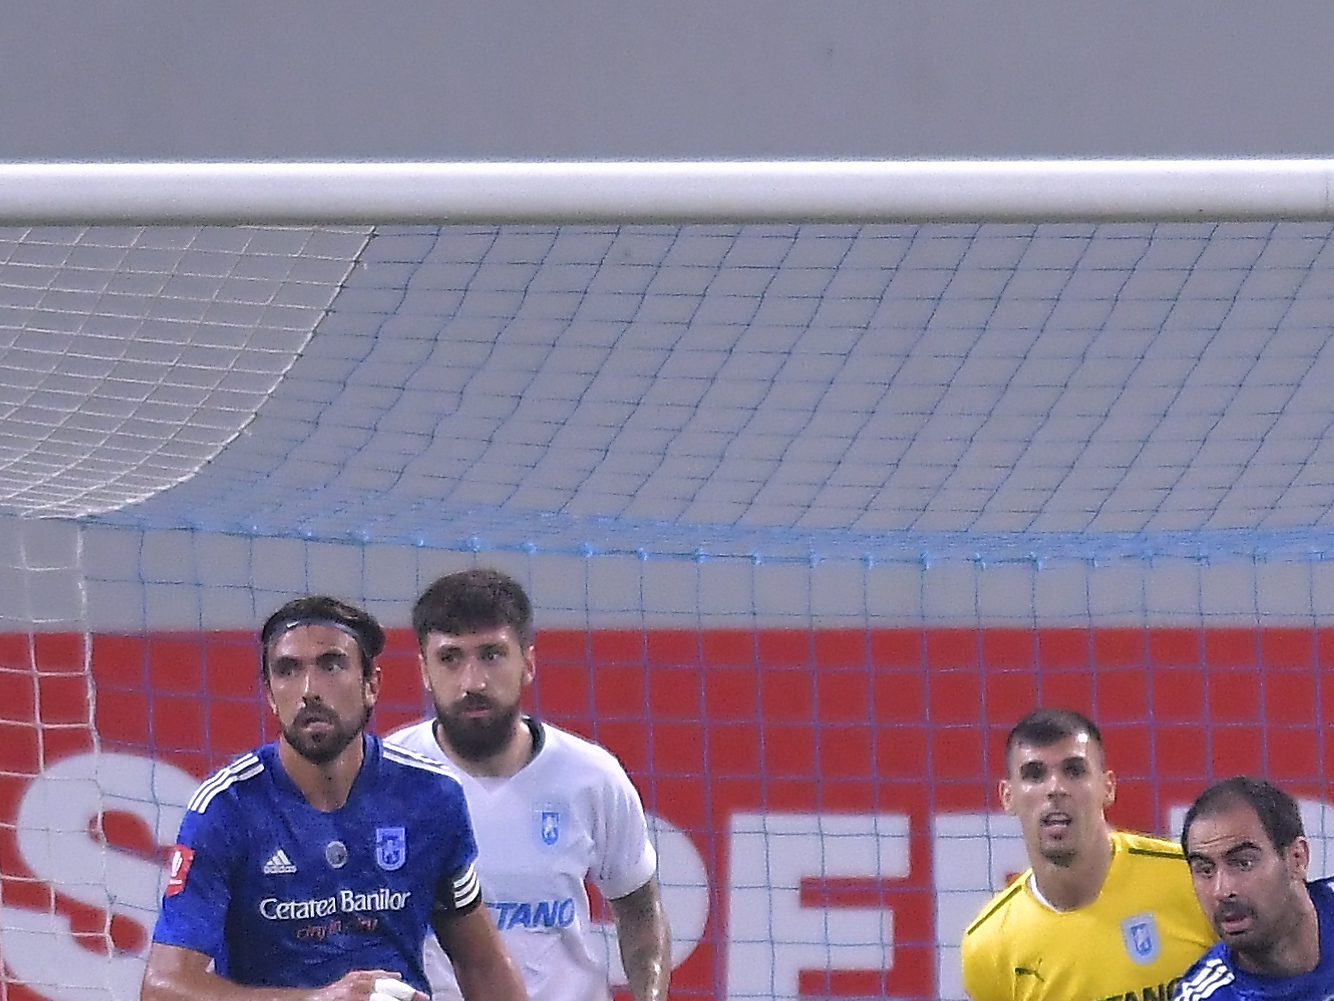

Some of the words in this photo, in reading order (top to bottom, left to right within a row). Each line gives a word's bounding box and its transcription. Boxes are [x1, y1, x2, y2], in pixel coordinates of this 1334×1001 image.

[260, 896, 336, 920] Cetatea
[340, 887, 411, 913] Banilor
[486, 897, 576, 930] TANO
